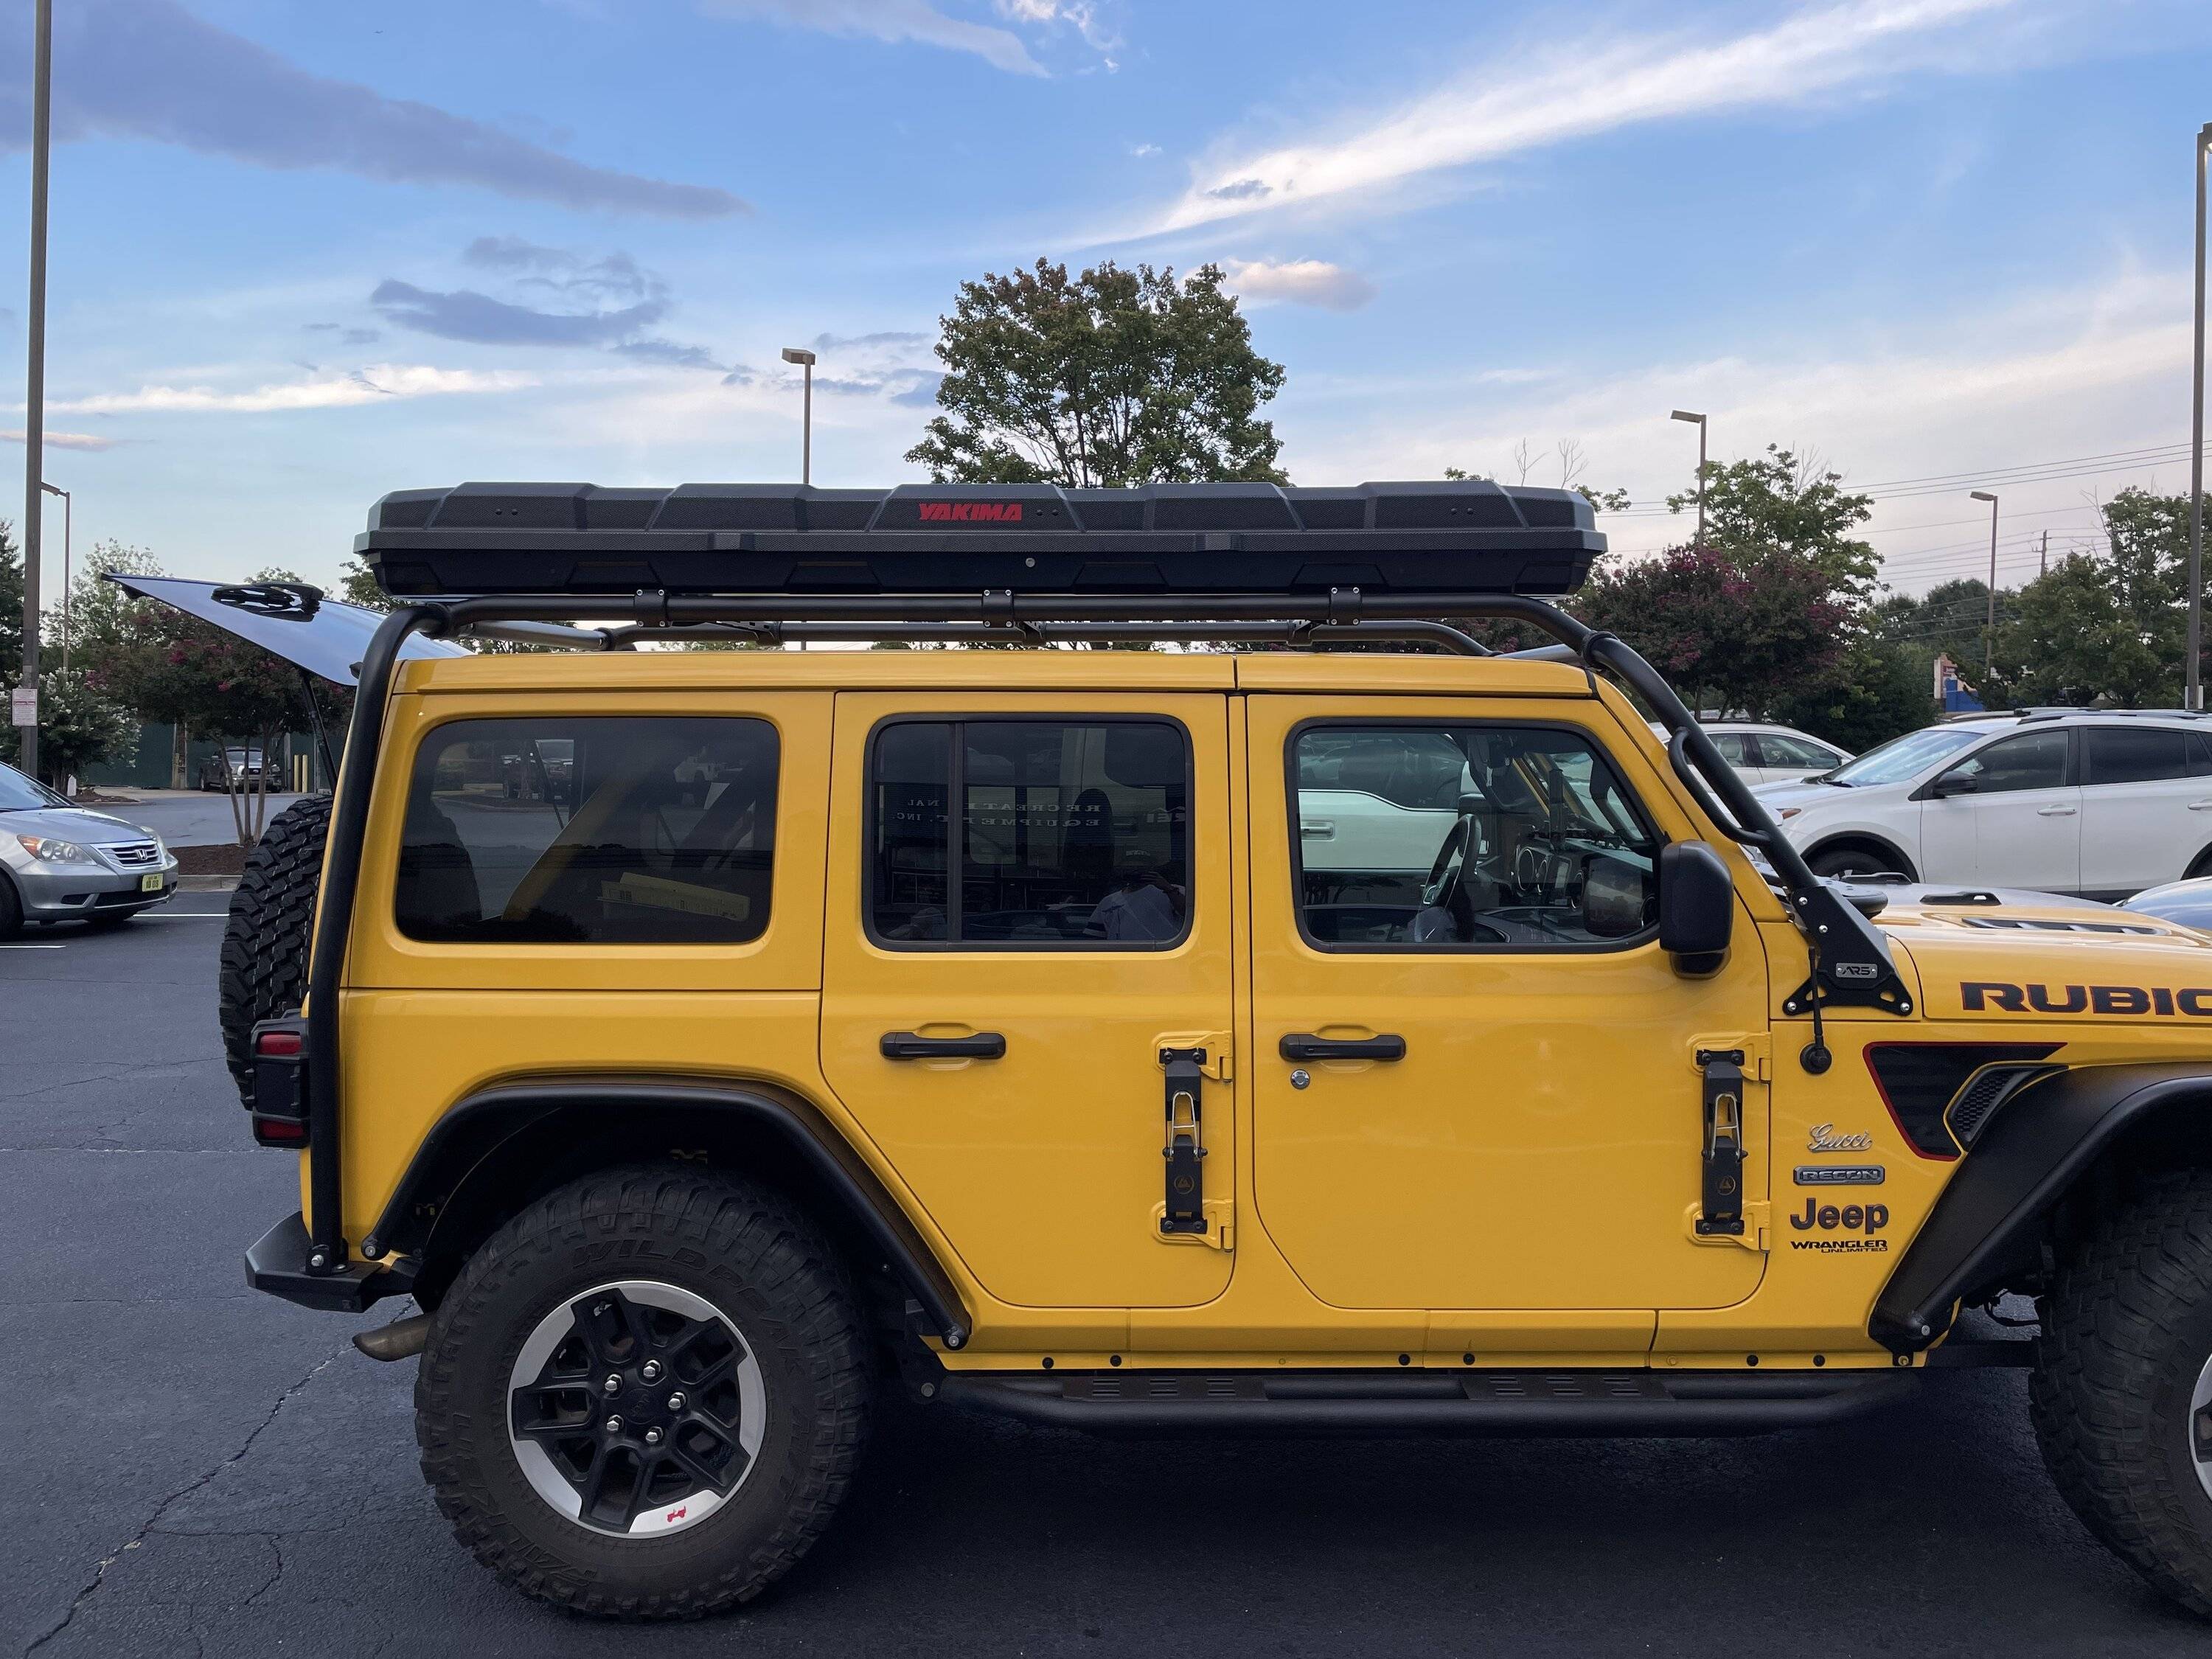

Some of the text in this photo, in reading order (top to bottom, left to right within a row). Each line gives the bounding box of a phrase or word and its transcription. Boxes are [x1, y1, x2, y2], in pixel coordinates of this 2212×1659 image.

[919, 503, 1022, 521] YAKIMA
[1843, 966, 1871, 975] ARS
[1807, 1124, 1873, 1152] Gucci
[1802, 1170, 1878, 1180] RECON
[1790, 1197, 1889, 1234] Jeep
[1791, 1239, 1888, 1249] WRANGLER
